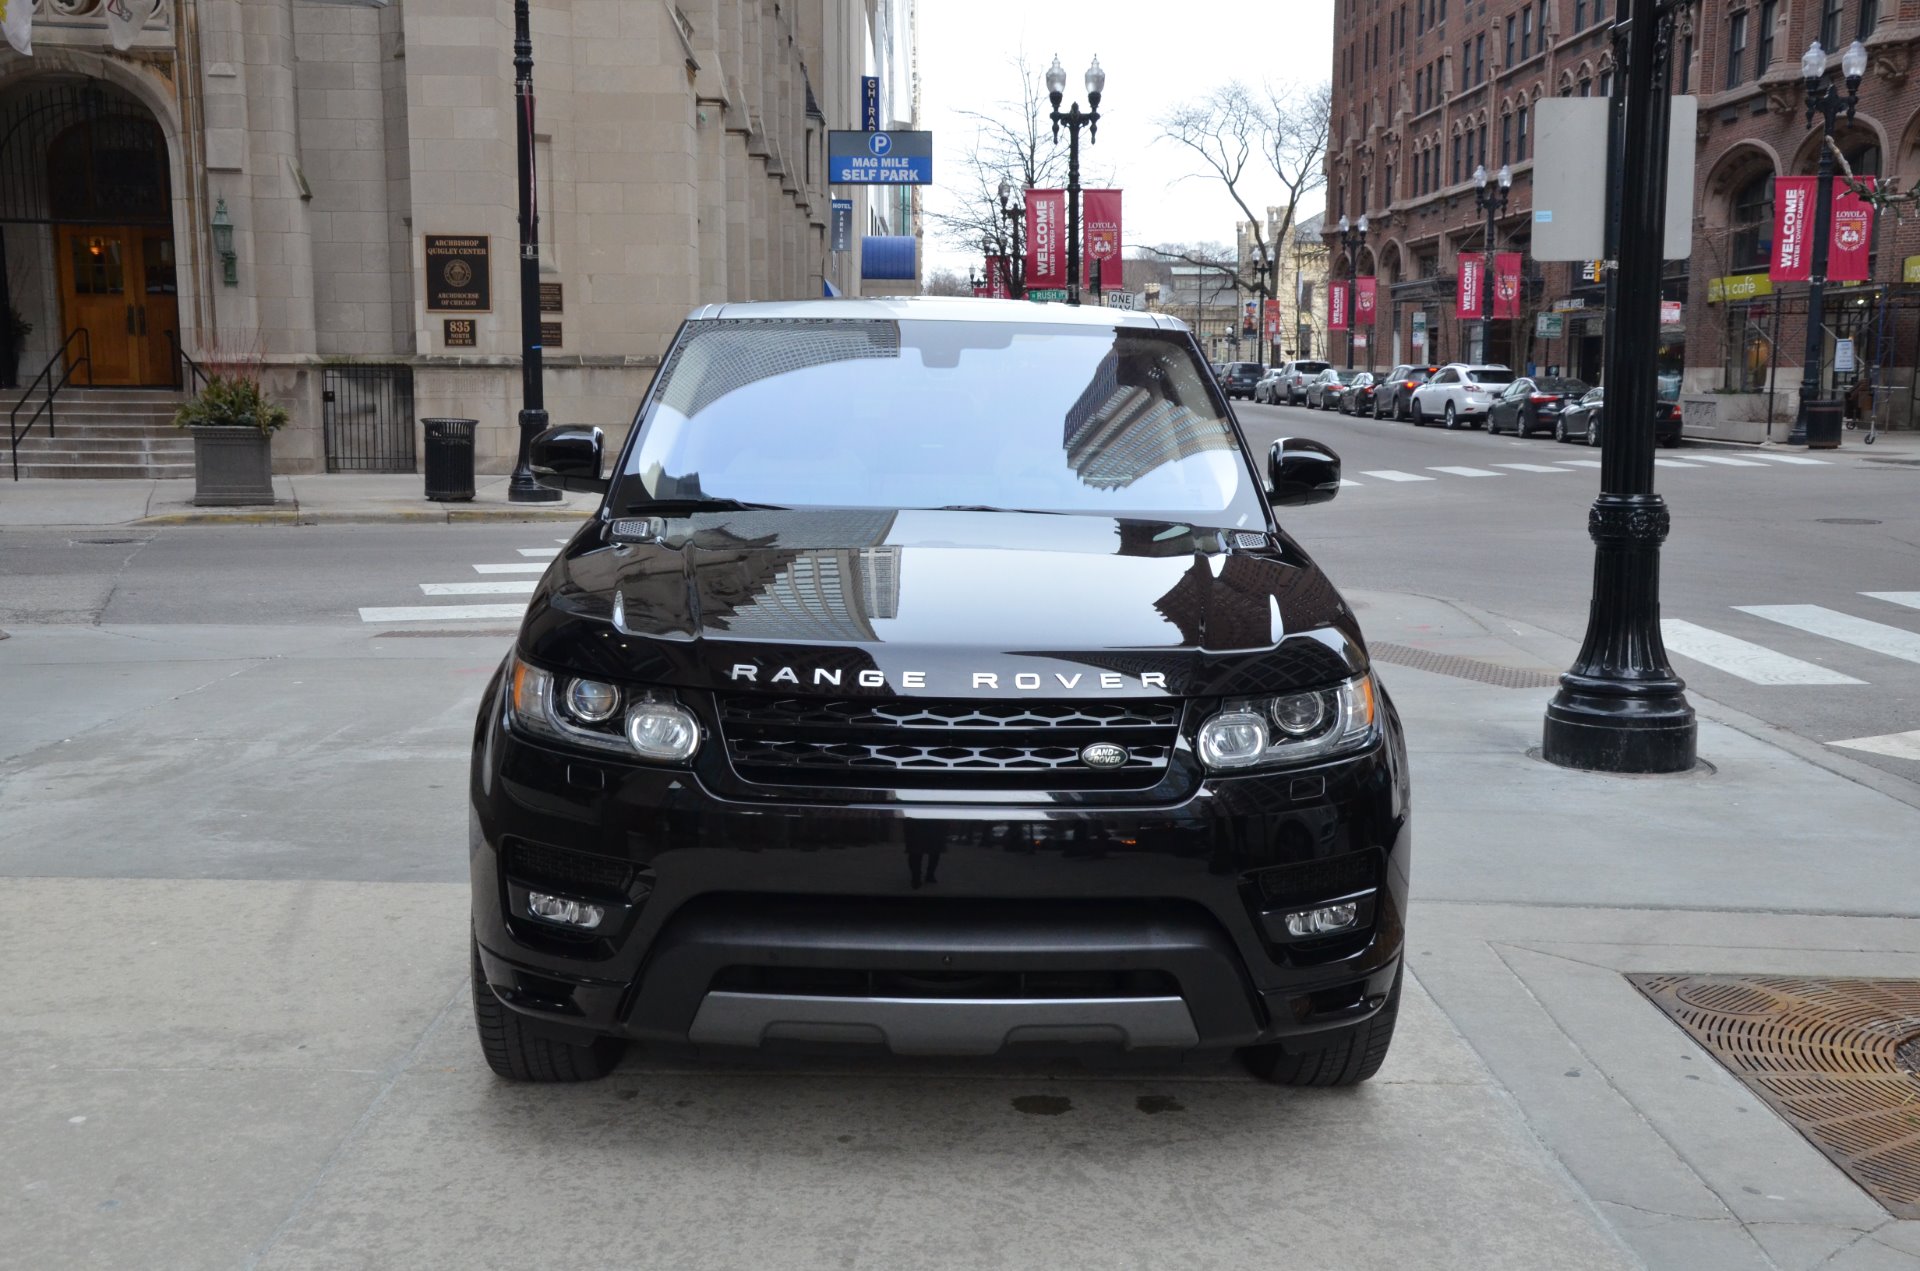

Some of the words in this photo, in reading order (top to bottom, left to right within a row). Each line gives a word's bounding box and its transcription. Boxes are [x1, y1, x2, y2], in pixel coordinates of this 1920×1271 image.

[875, 137, 887, 153] P
[852, 158, 878, 168] MAG
[881, 158, 909, 168] MILE
[842, 169, 876, 181] SELF
[881, 169, 918, 181] PARK
[1797, 189, 1805, 219] CAMPUS
[1836, 210, 1867, 218] LOYOLA
[1780, 189, 1798, 268] WELCOME
[1795, 220, 1803, 244] TOWER
[434, 239, 480, 247] ARCHBISHOP
[1036, 200, 1048, 276] WELCOME
[1793, 245, 1801, 268] WATER
[1463, 261, 1473, 311] WELCOME
[1732, 276, 1756, 294] café
[1037, 291, 1057, 300] RUSH
[1111, 294, 1131, 304] ONE
[449, 321, 471, 333] 835
[731, 663, 927, 689] RANGE
[972, 671, 1168, 690] ROVER
